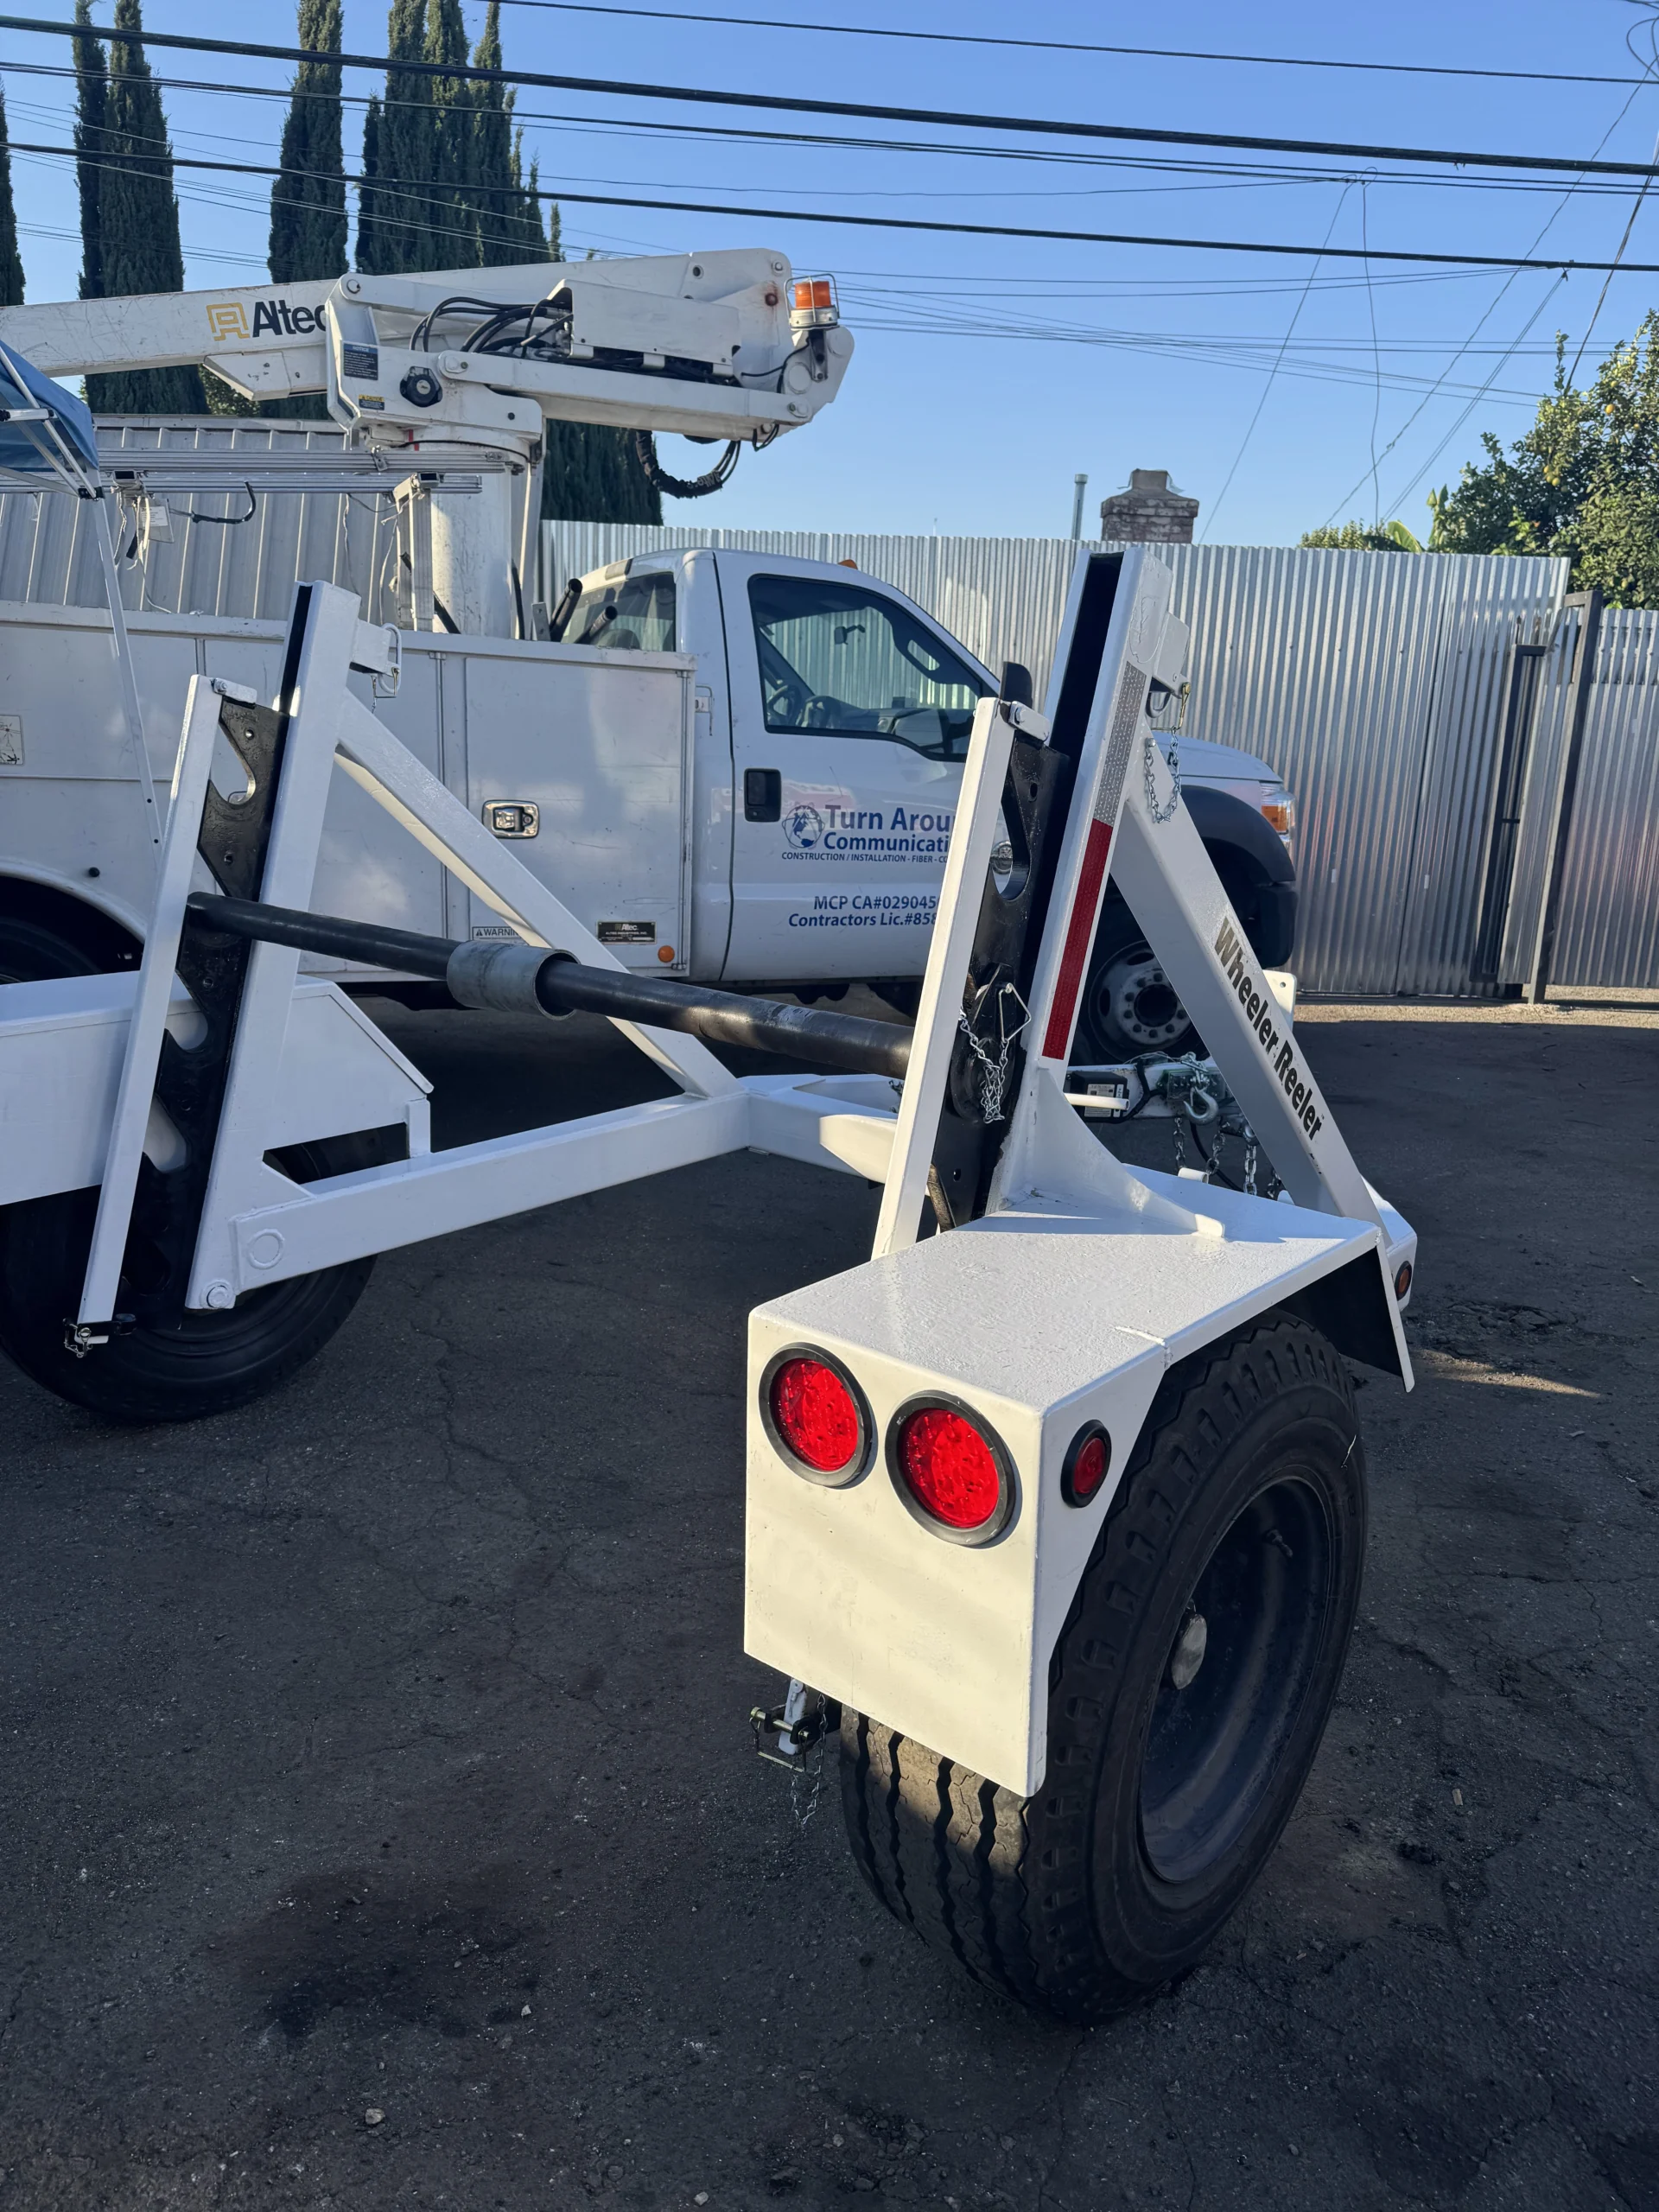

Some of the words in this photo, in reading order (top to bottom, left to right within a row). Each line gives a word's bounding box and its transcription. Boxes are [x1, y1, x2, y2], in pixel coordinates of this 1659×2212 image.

[252, 300, 326, 337] Altec
[824, 804, 883, 830] Turn
[890, 807, 956, 832] Arou
[823, 831, 950, 853] Communicati
[781, 852, 844, 861] CONSTRUCTION
[851, 853, 906, 862] INSTALLATION
[912, 855, 933, 863] FIBER
[814, 895, 848, 909] MCP
[852, 895, 940, 910] CA#029045
[788, 912, 876, 927] Contractors
[1214, 917, 1279, 1052] Wheeler
[1274, 1039, 1322, 1141] Reeler
